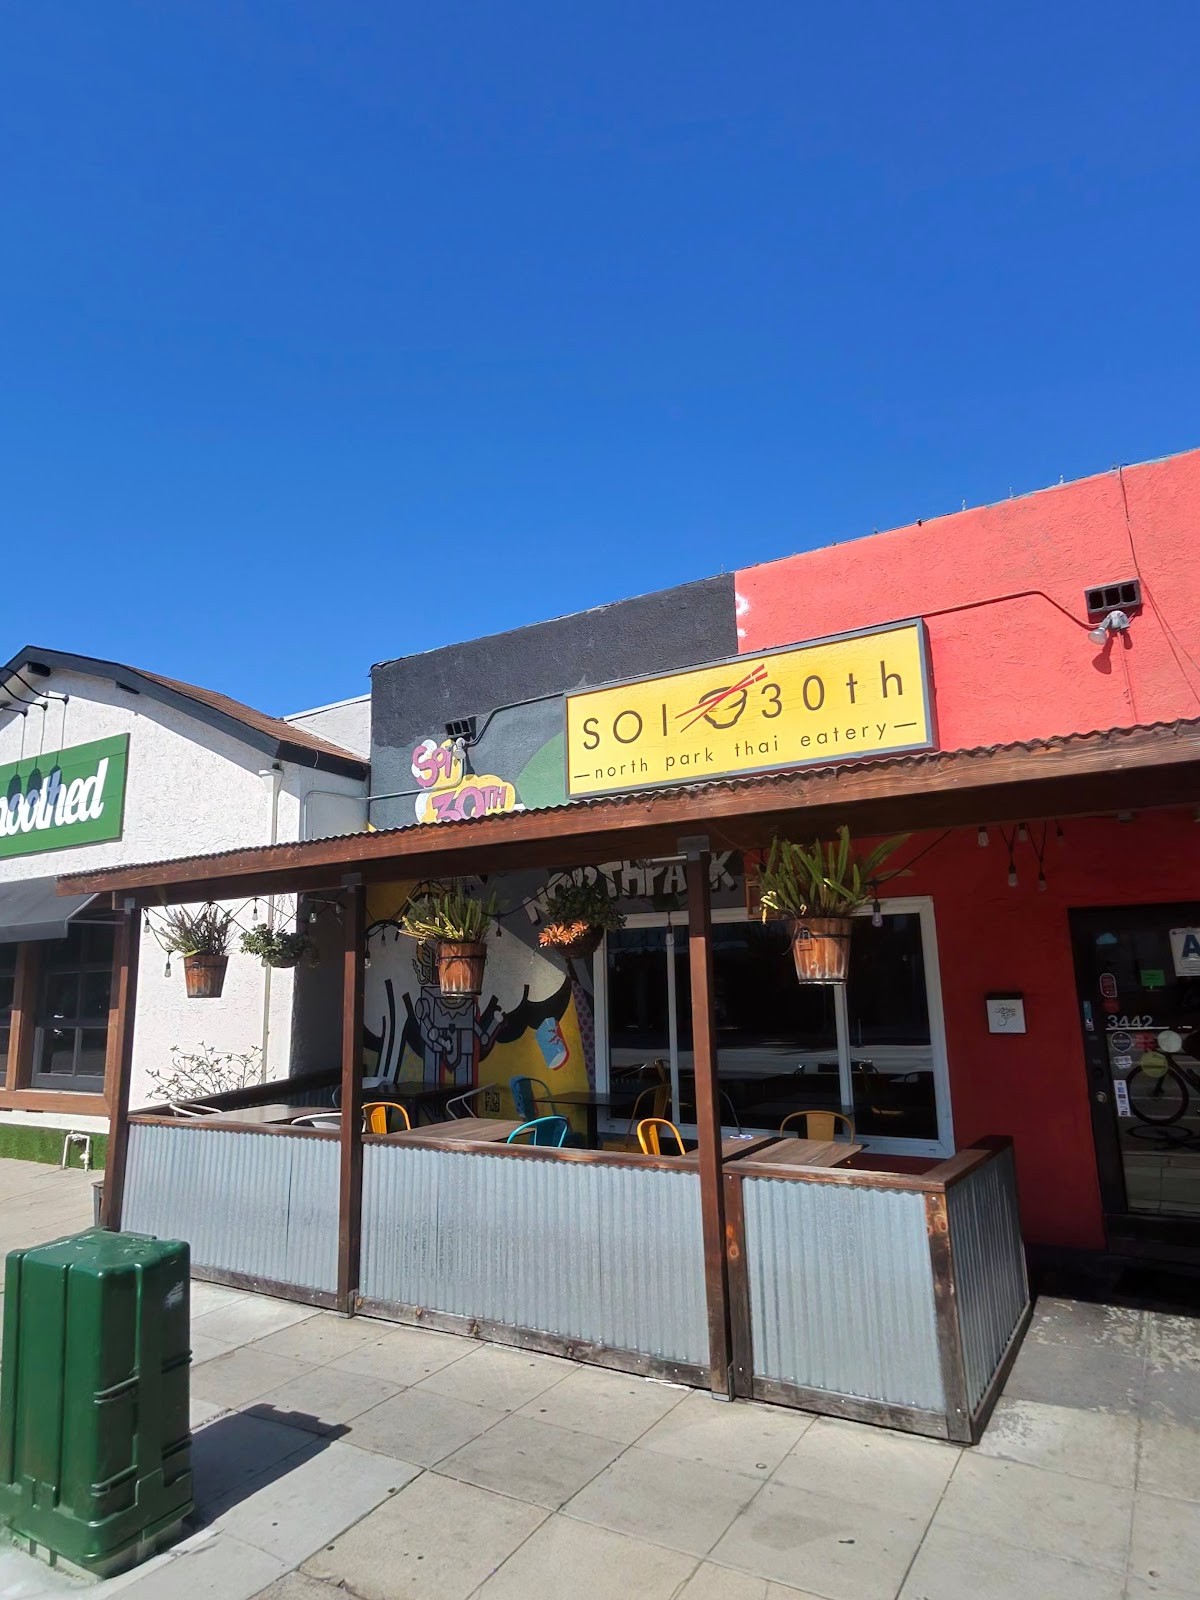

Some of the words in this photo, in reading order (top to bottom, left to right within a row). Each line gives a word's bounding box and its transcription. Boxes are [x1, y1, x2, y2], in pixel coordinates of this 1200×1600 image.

[582, 703, 668, 750] SOI
[761, 660, 903, 719] 30th
[595, 758, 648, 779] north
[665, 748, 714, 771] park
[734, 735, 779, 758] thai
[800, 722, 887, 748] eatery
[1181, 934, 1200, 958] A
[1107, 1014, 1153, 1029] 3442
